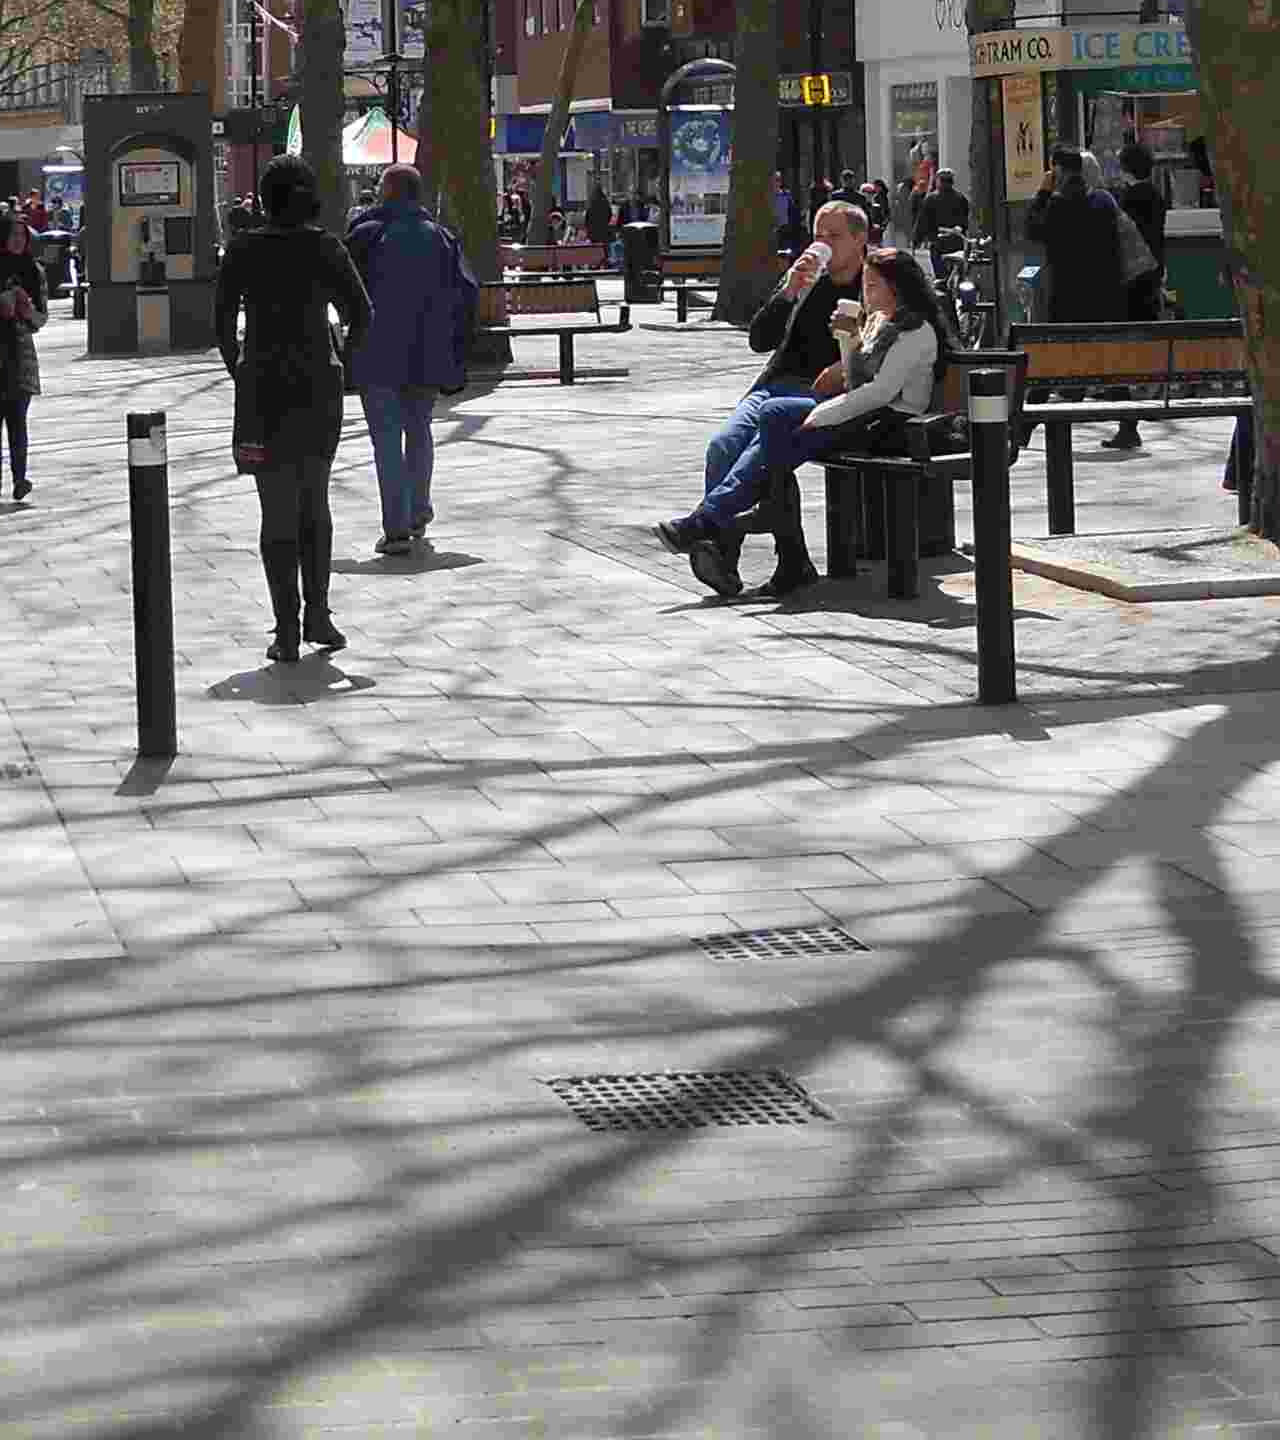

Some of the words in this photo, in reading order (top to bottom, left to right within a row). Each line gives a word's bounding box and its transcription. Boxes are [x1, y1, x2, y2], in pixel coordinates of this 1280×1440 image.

[987, 39, 1021, 62] TRAM
[1027, 37, 1053, 59] CO.
[1071, 32, 1121, 59] ICE
[1135, 31, 1191, 58] CRE
